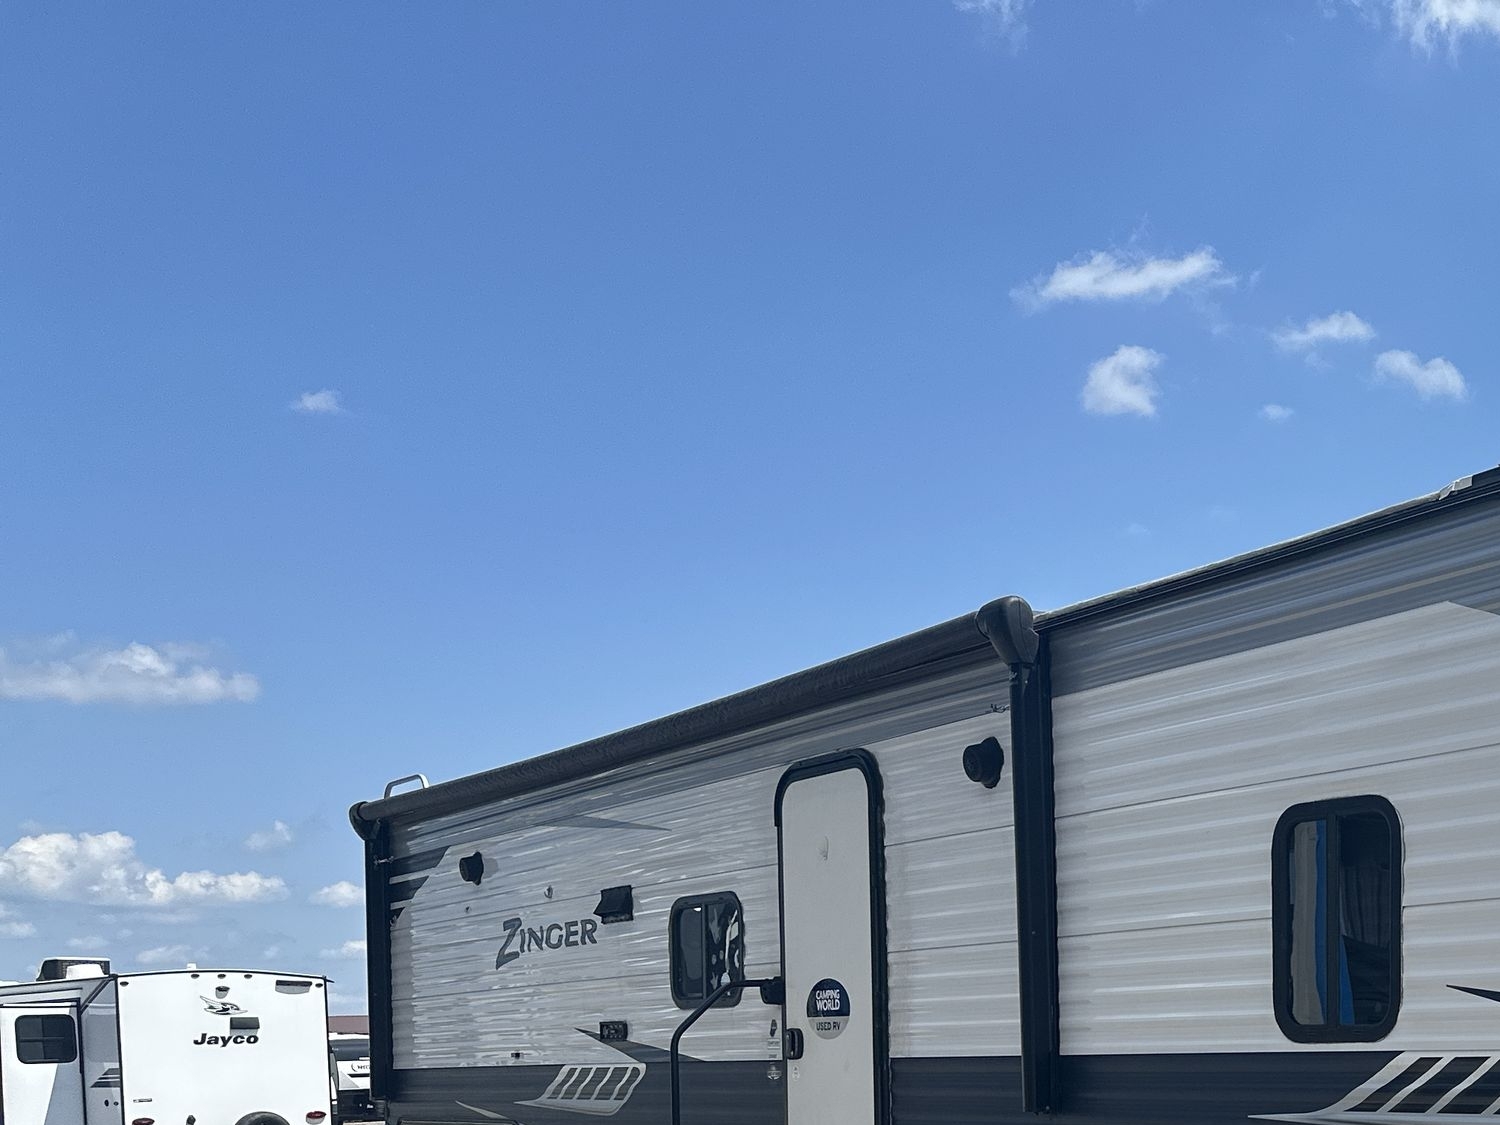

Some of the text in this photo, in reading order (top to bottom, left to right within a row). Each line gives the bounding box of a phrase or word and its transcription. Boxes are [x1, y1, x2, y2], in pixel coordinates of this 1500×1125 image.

[495, 917, 598, 970] ZINGER
[815, 989, 840, 1000] CAMPING
[816, 999, 840, 1011] WORLD
[816, 1021, 841, 1031] USED RV
[193, 1032, 259, 1048] Jayco
